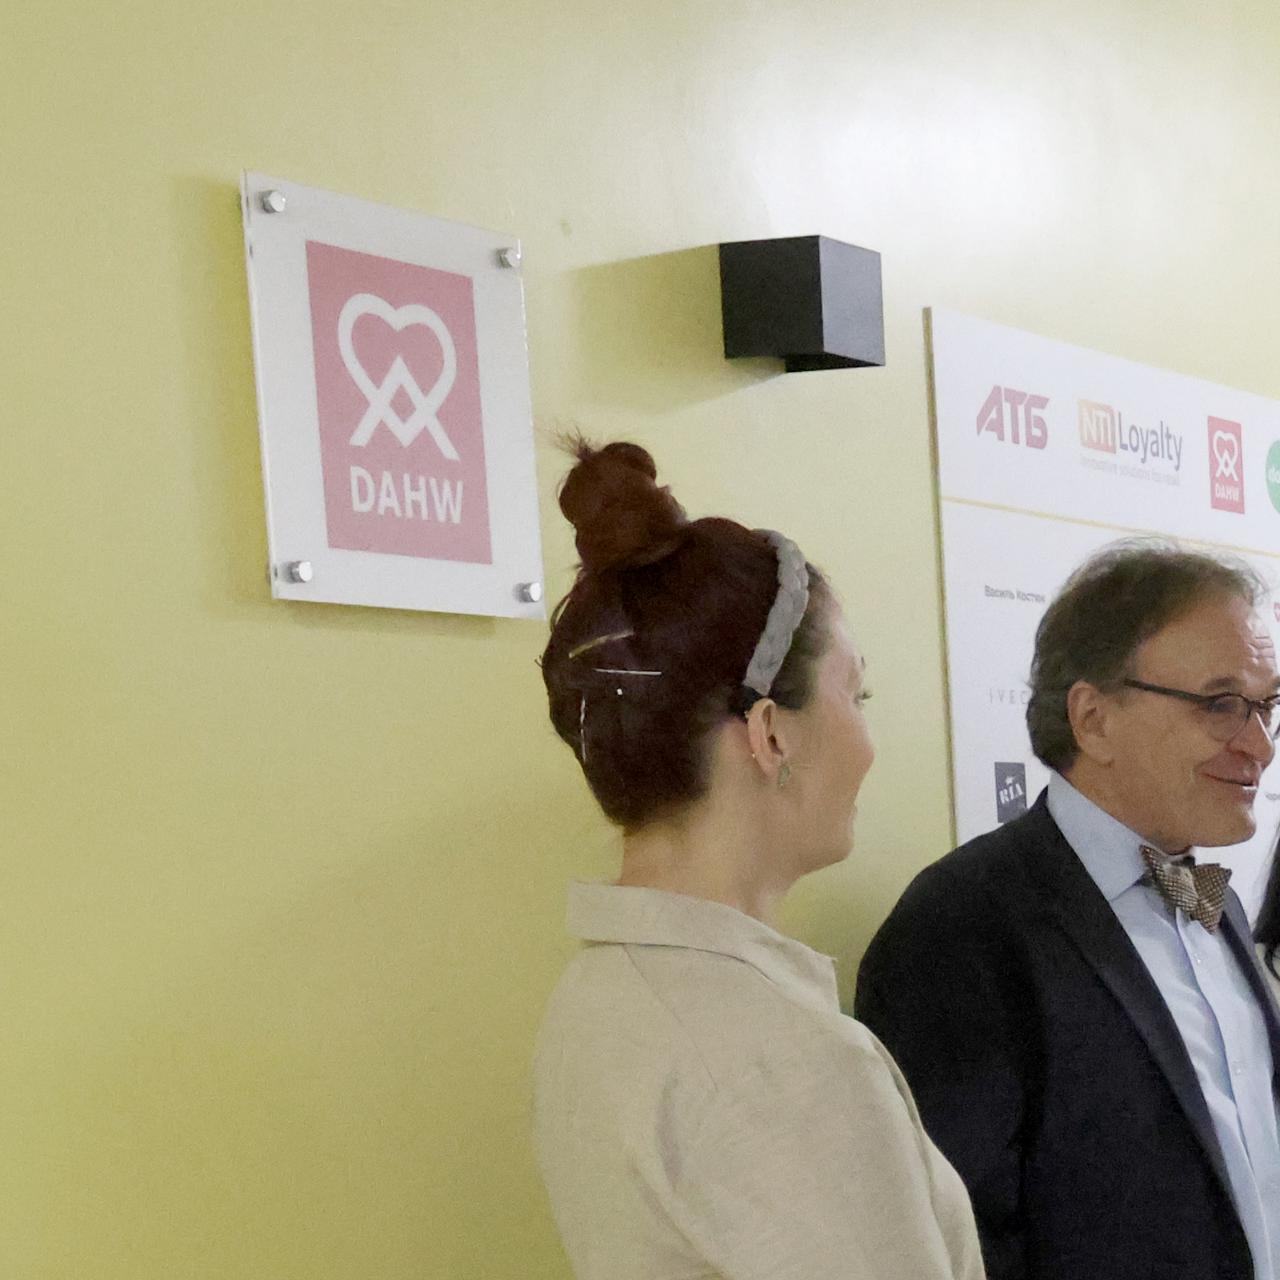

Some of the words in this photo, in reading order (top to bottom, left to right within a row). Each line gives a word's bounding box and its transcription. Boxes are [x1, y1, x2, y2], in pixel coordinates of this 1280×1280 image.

[976, 384, 1050, 450] АТБ
[1118, 411, 1183, 472] Loyalty
[350, 465, 463, 524] DAHW
[1215, 483, 1240, 501] DAHW
[989, 687, 1029, 705] IVEC
